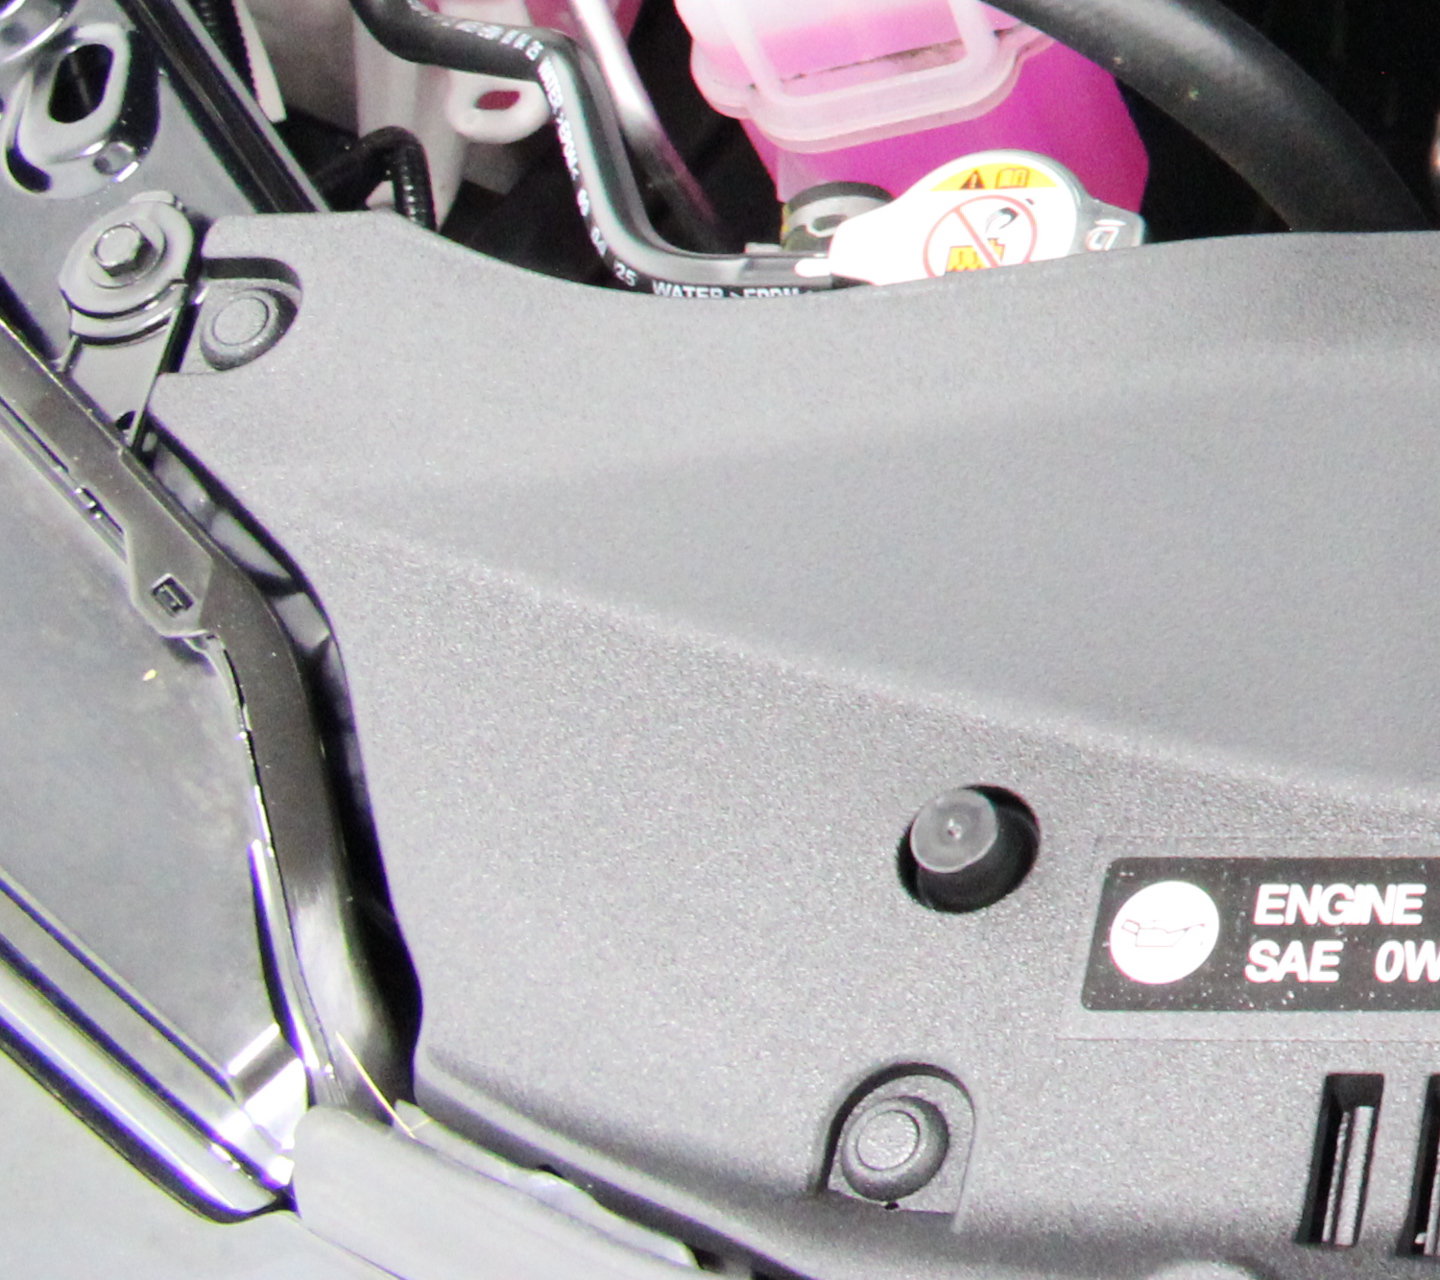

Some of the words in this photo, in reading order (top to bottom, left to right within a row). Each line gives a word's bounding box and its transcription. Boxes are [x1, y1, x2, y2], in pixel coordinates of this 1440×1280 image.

[612, 259, 639, 287] 25
[1253, 883, 1427, 927] ENGINE
[1244, 939, 1345, 983] SAE
